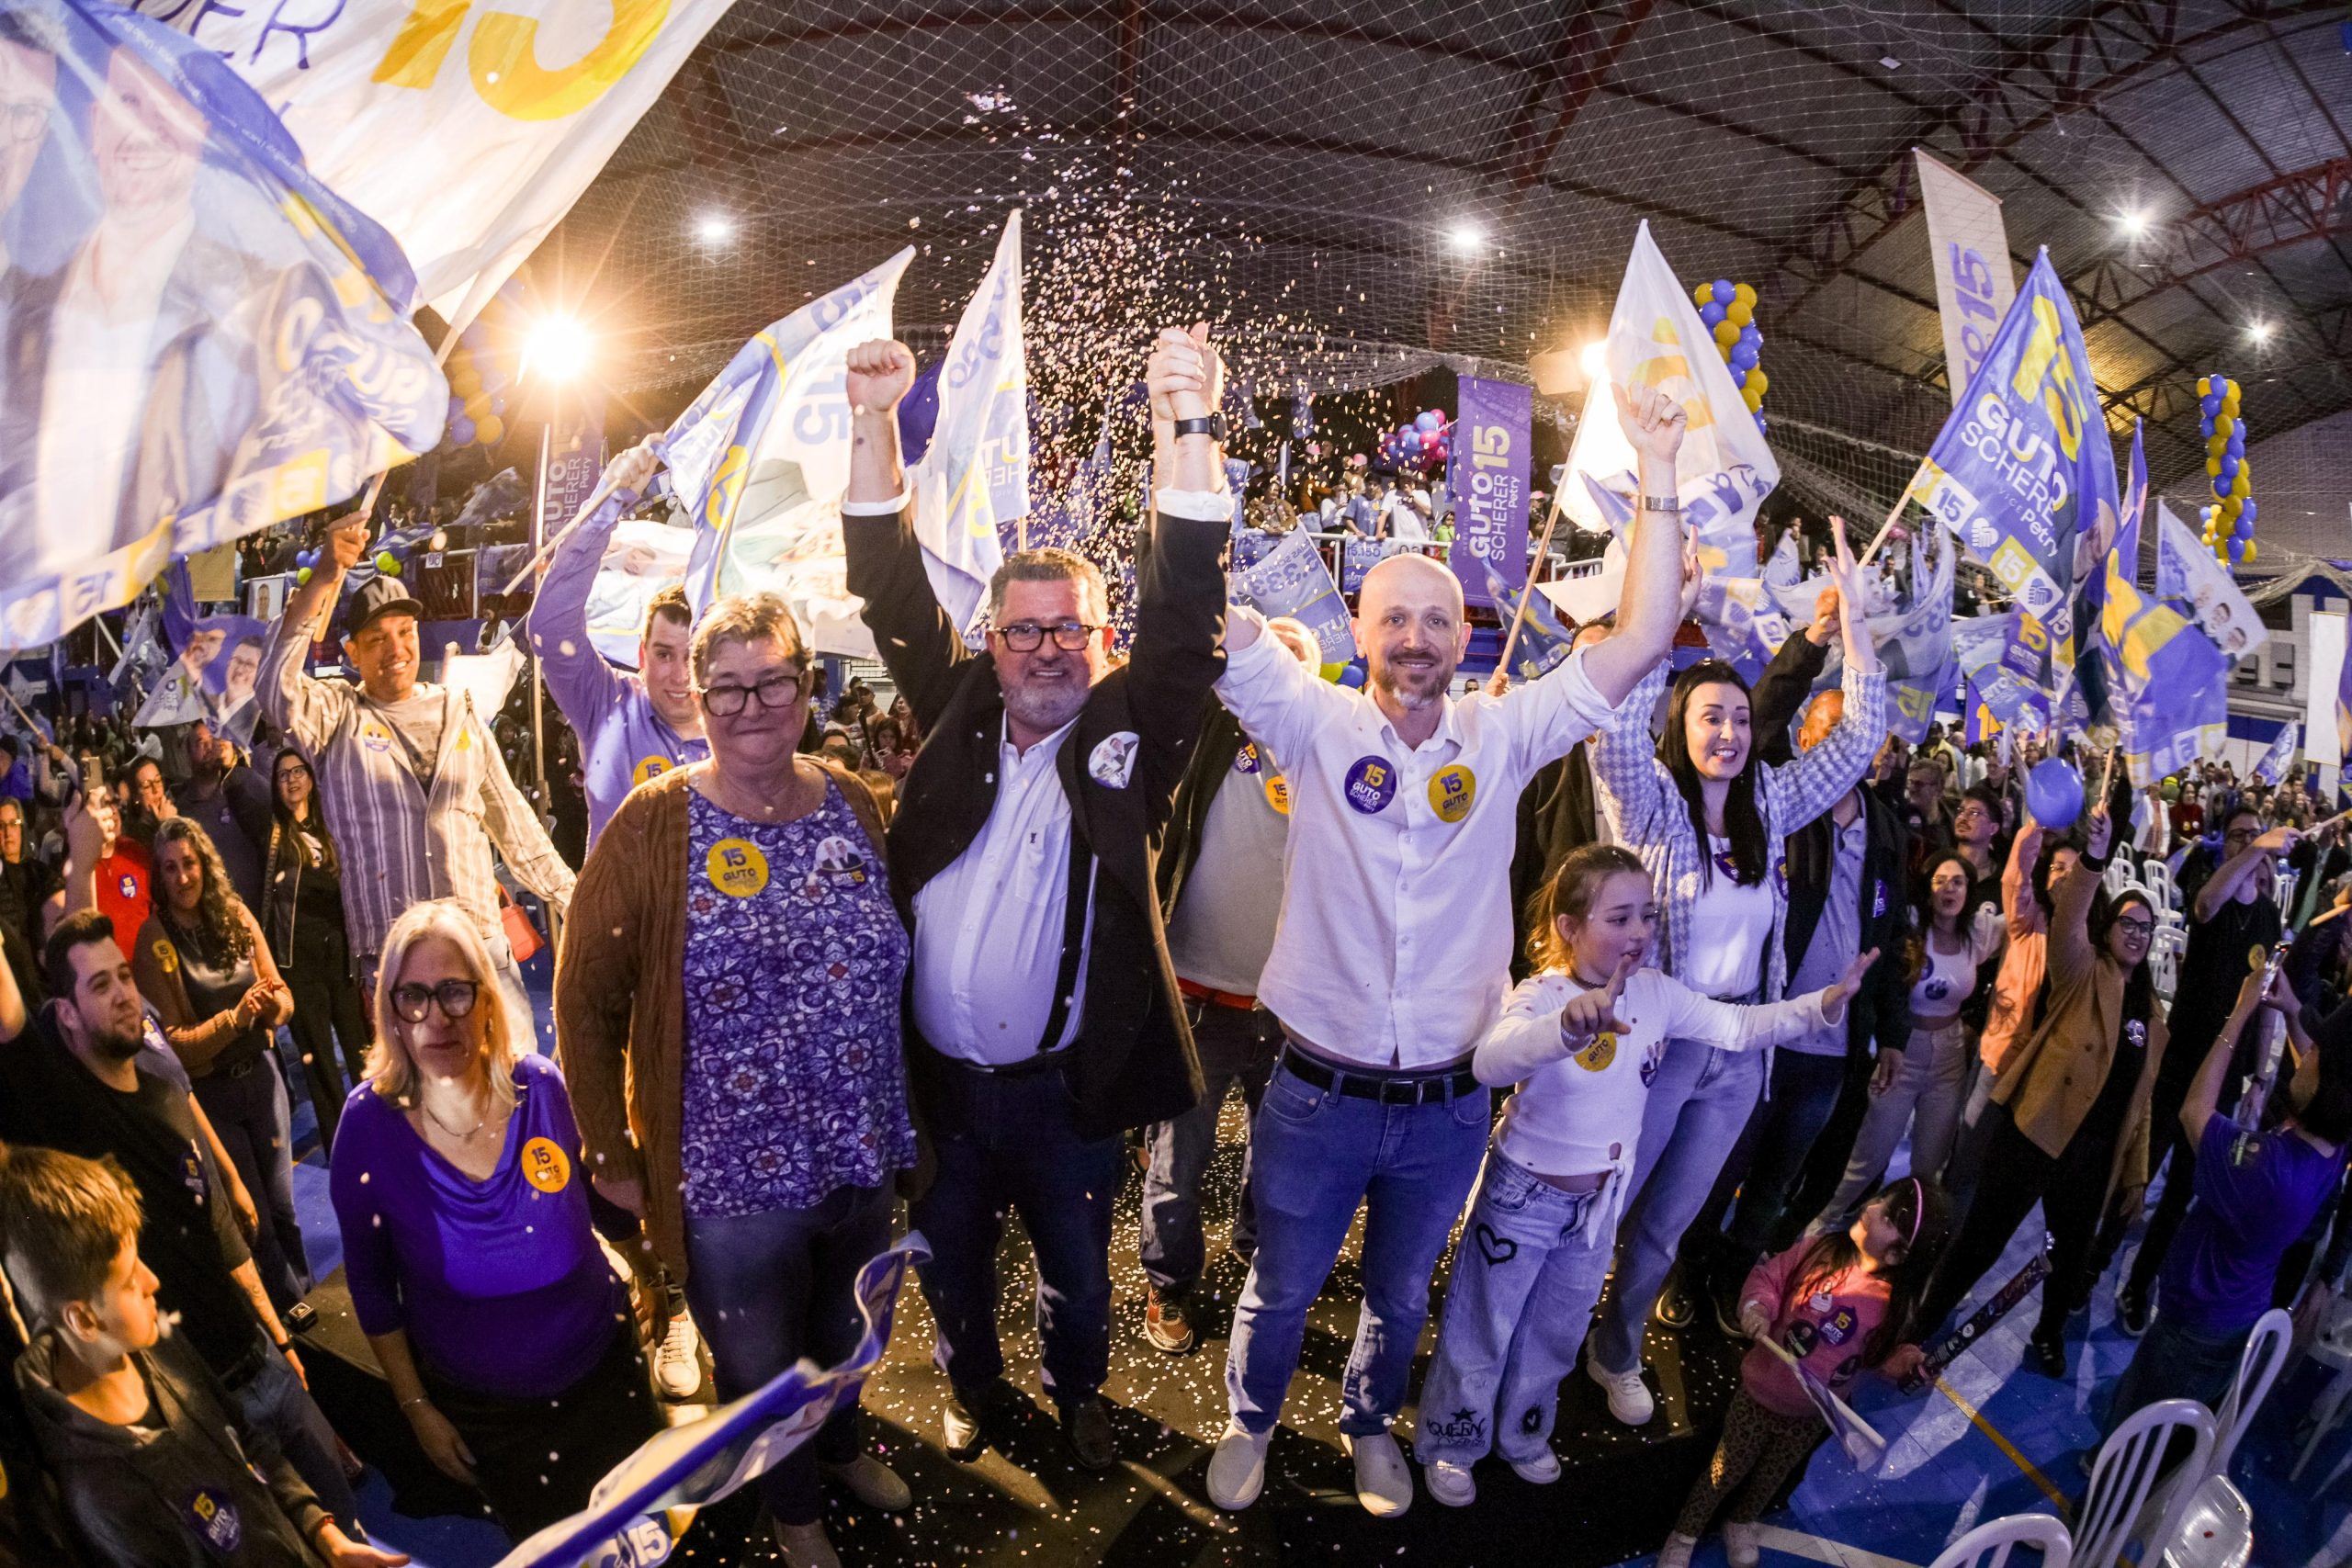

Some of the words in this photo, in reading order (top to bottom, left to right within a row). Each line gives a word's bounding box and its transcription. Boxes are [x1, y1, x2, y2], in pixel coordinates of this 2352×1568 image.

[1949, 243, 1997, 322] 15
[2011, 294, 2088, 462] 15
[1472, 425, 1510, 468] 15
[1976, 393, 2067, 512] GUTO
[563, 457, 582, 525] HERER
[1960, 421, 2054, 526] SCHERE
[1508, 475, 1521, 508] Petry
[1937, 488, 1962, 523] 15
[1470, 471, 1494, 558] GUTO
[1490, 473, 1509, 561] SCHERER
[2020, 509, 2058, 558] Petry
[1999, 548, 2027, 583] 15
[2018, 613, 2048, 652] 15
[2048, 607, 2071, 636] 15
[645, 763, 662, 778] 15
[1363, 763, 1386, 787] 15
[1440, 773, 1463, 795] 15
[1351, 782, 1381, 801] GUTO
[1442, 792, 1468, 810] GUTO
[721, 847, 746, 867] 15
[723, 867, 755, 882] GUTO
[1588, 1039, 1610, 1062] GUTO
[532, 1146, 551, 1165] 15
[193, 1492, 216, 1521] 15
[628, 1520, 668, 1567] 15
